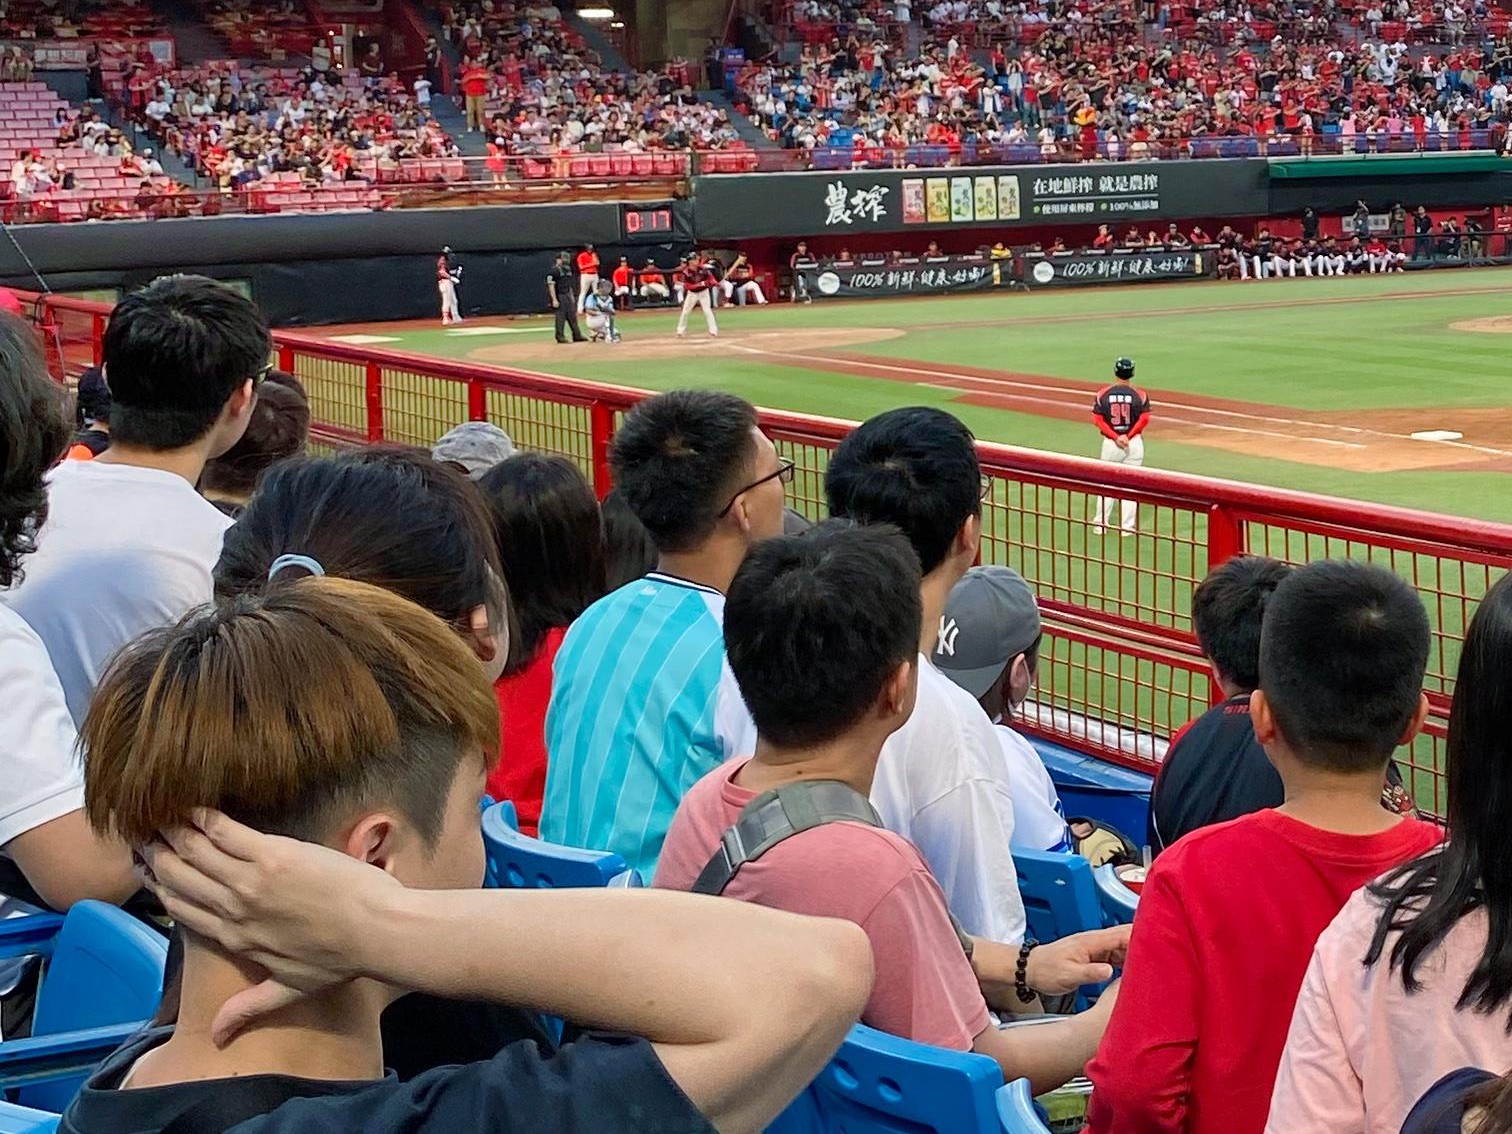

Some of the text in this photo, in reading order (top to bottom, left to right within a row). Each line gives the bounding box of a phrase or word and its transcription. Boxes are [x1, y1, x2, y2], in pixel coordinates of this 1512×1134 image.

[626, 209, 670, 232] 0:17
[1063, 261, 1097, 277] 100%
[850, 271, 885, 288] 100%
